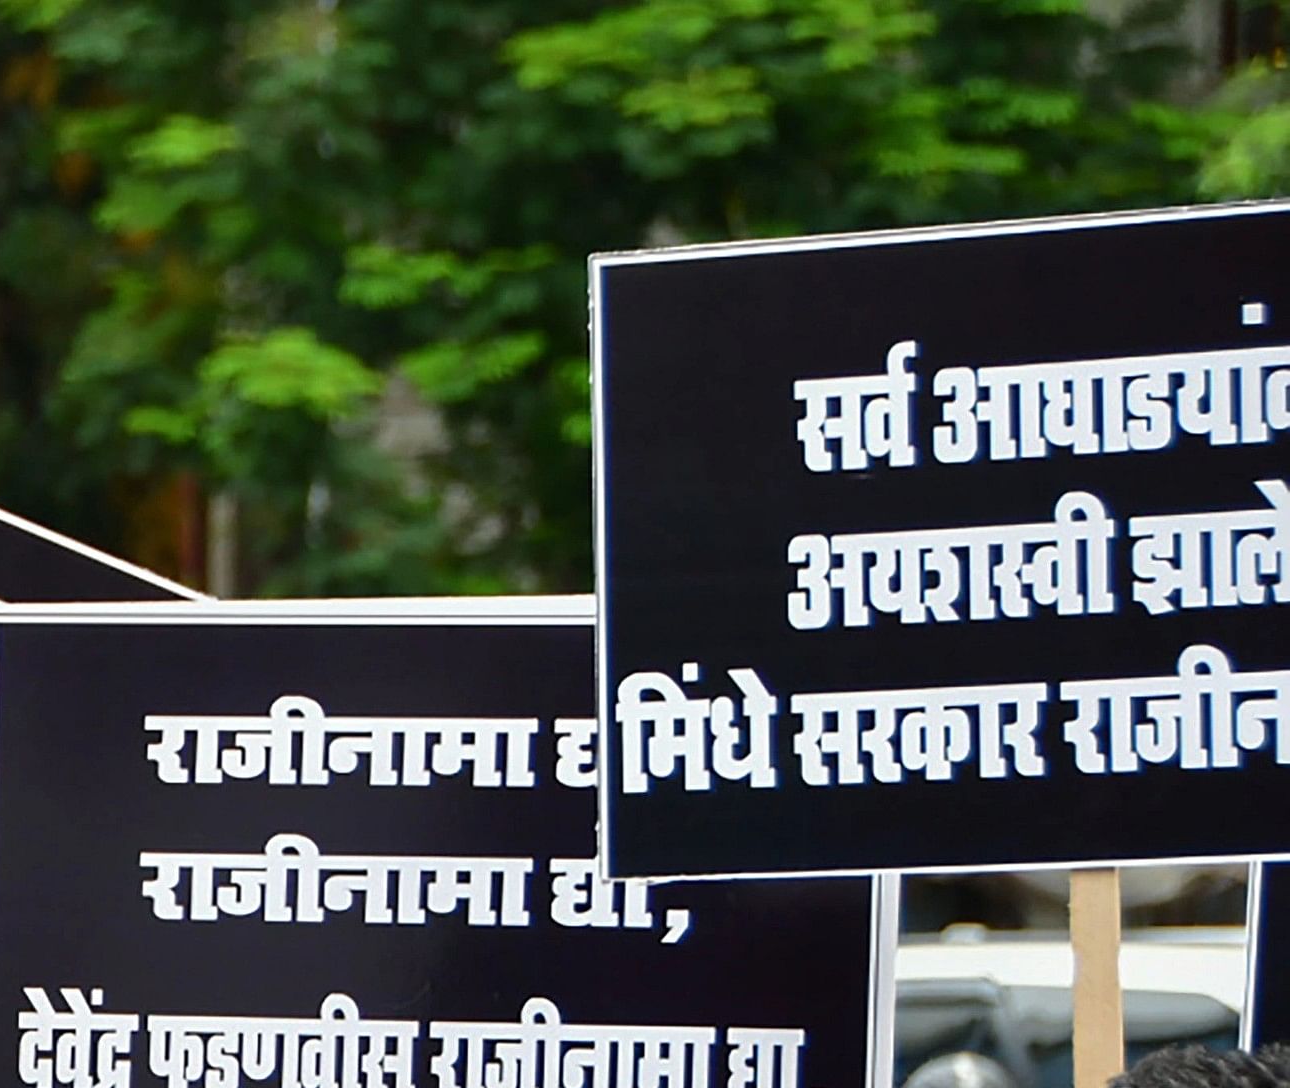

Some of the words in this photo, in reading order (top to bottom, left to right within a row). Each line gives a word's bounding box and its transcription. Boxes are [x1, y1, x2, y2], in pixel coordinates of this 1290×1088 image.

[794, 341, 917, 472] सर्व
[788, 491, 1115, 630] अयशस्वी
[145, 696, 539, 788] राजीनामा
[616, 663, 778, 794] मिंधे
[791, 683, 1048, 786] सरकार
[140, 834, 534, 927] राजीनामा
